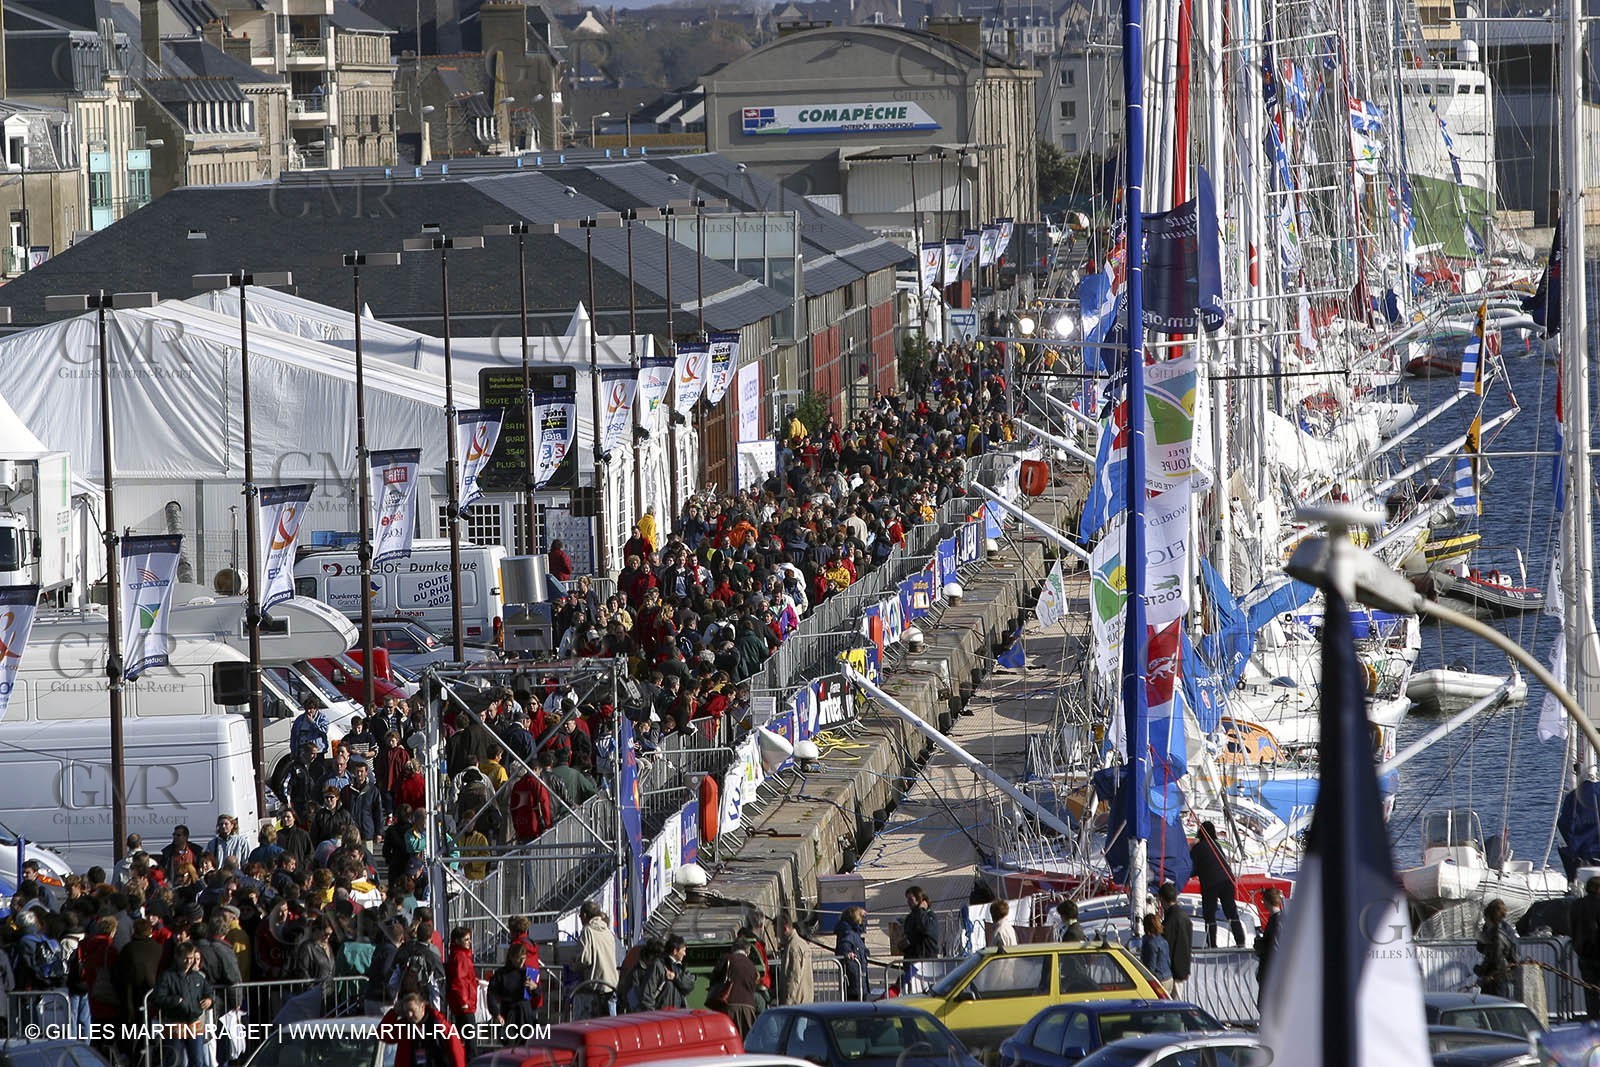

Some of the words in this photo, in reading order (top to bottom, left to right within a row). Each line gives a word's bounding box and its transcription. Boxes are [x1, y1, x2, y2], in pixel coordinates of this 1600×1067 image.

[798, 104, 908, 123] COMAPÊCHE
[345, 561, 401, 575] arelor
[418, 574, 449, 592] ROUTE
[413, 592, 428, 603] DU
[429, 582, 453, 598] RHU
[427, 594, 450, 608] 2002
